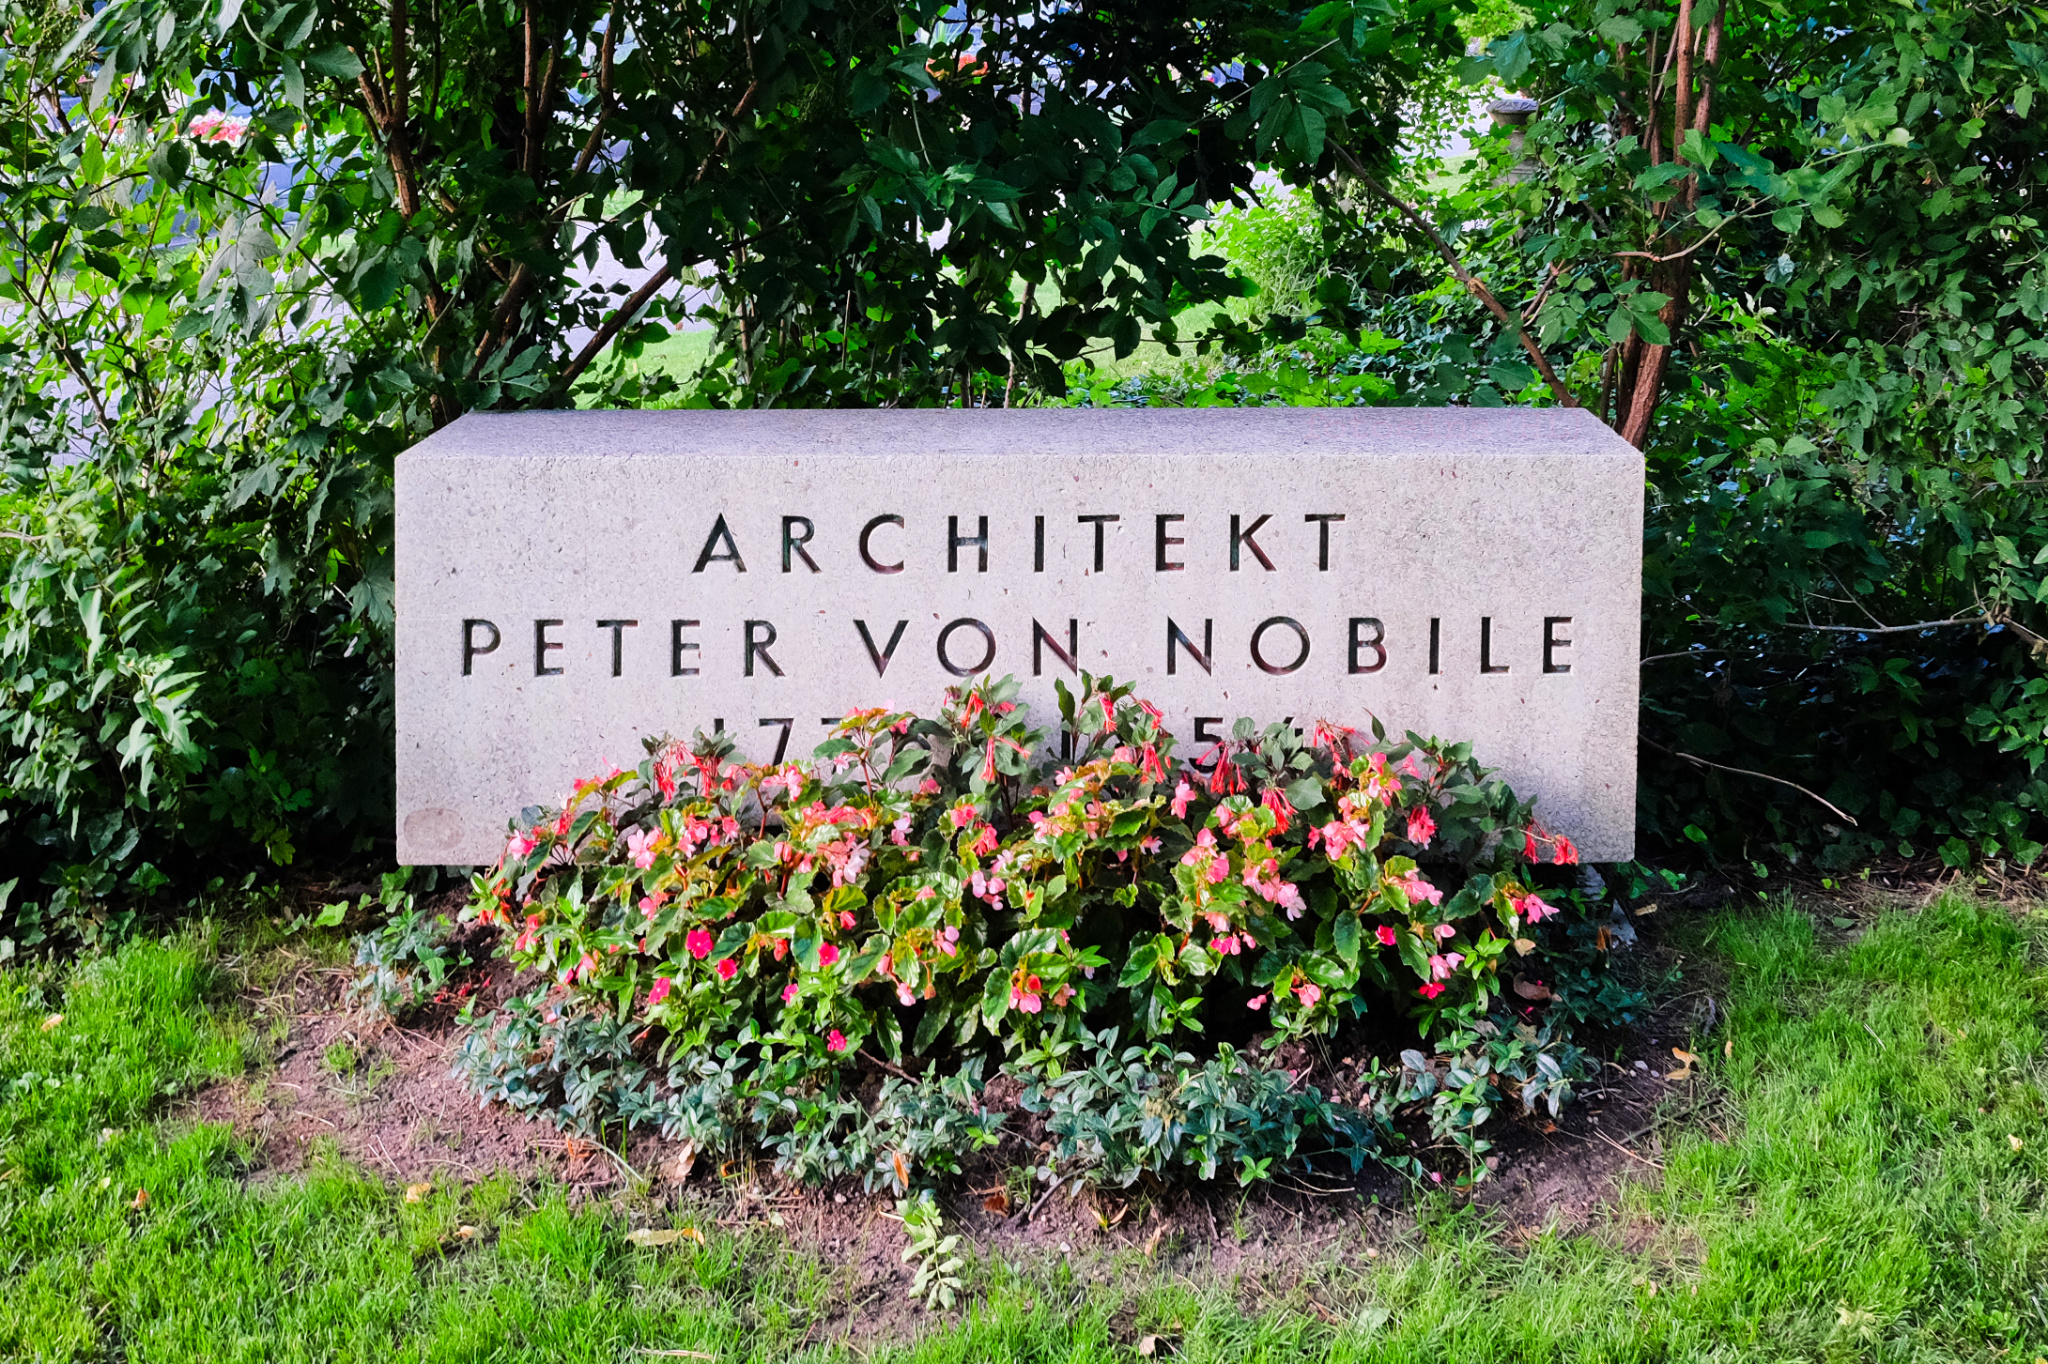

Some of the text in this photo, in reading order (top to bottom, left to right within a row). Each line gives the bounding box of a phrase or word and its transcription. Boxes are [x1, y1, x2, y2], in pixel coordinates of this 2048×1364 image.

[691, 513, 1346, 574] ARCHITEKT
[461, 615, 1573, 678] PETER VON NOBILE
